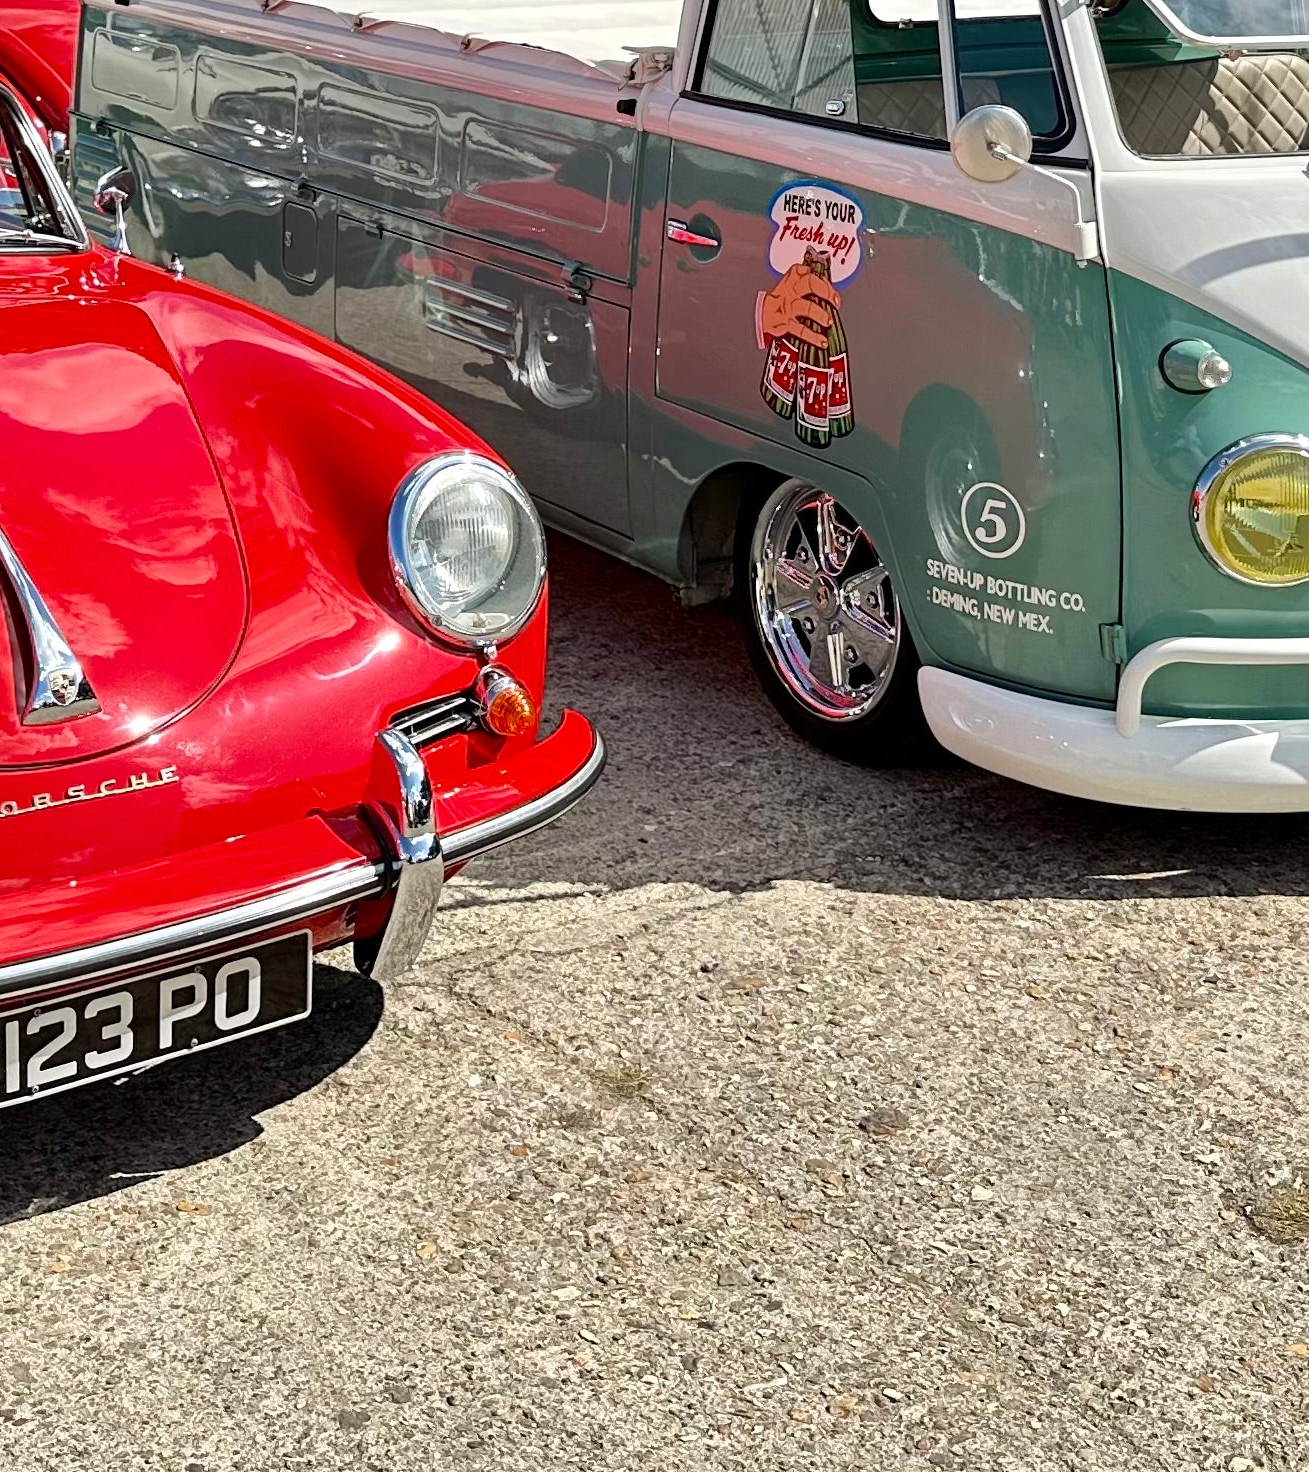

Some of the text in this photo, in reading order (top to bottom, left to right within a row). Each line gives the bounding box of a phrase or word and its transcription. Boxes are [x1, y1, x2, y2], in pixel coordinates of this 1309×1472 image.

[783, 194, 855, 224] HERE'S YOUR
[779, 216, 855, 264] Fresh up!
[975, 499, 1007, 543] 5
[926, 559, 1086, 613] SEVEN-UP BOTTLING CO.
[932, 586, 981, 620] DEMING,
[984, 602, 1015, 625] NEW
[1018, 611, 1053, 634] MEX.
[159, 956, 262, 1050] PO
